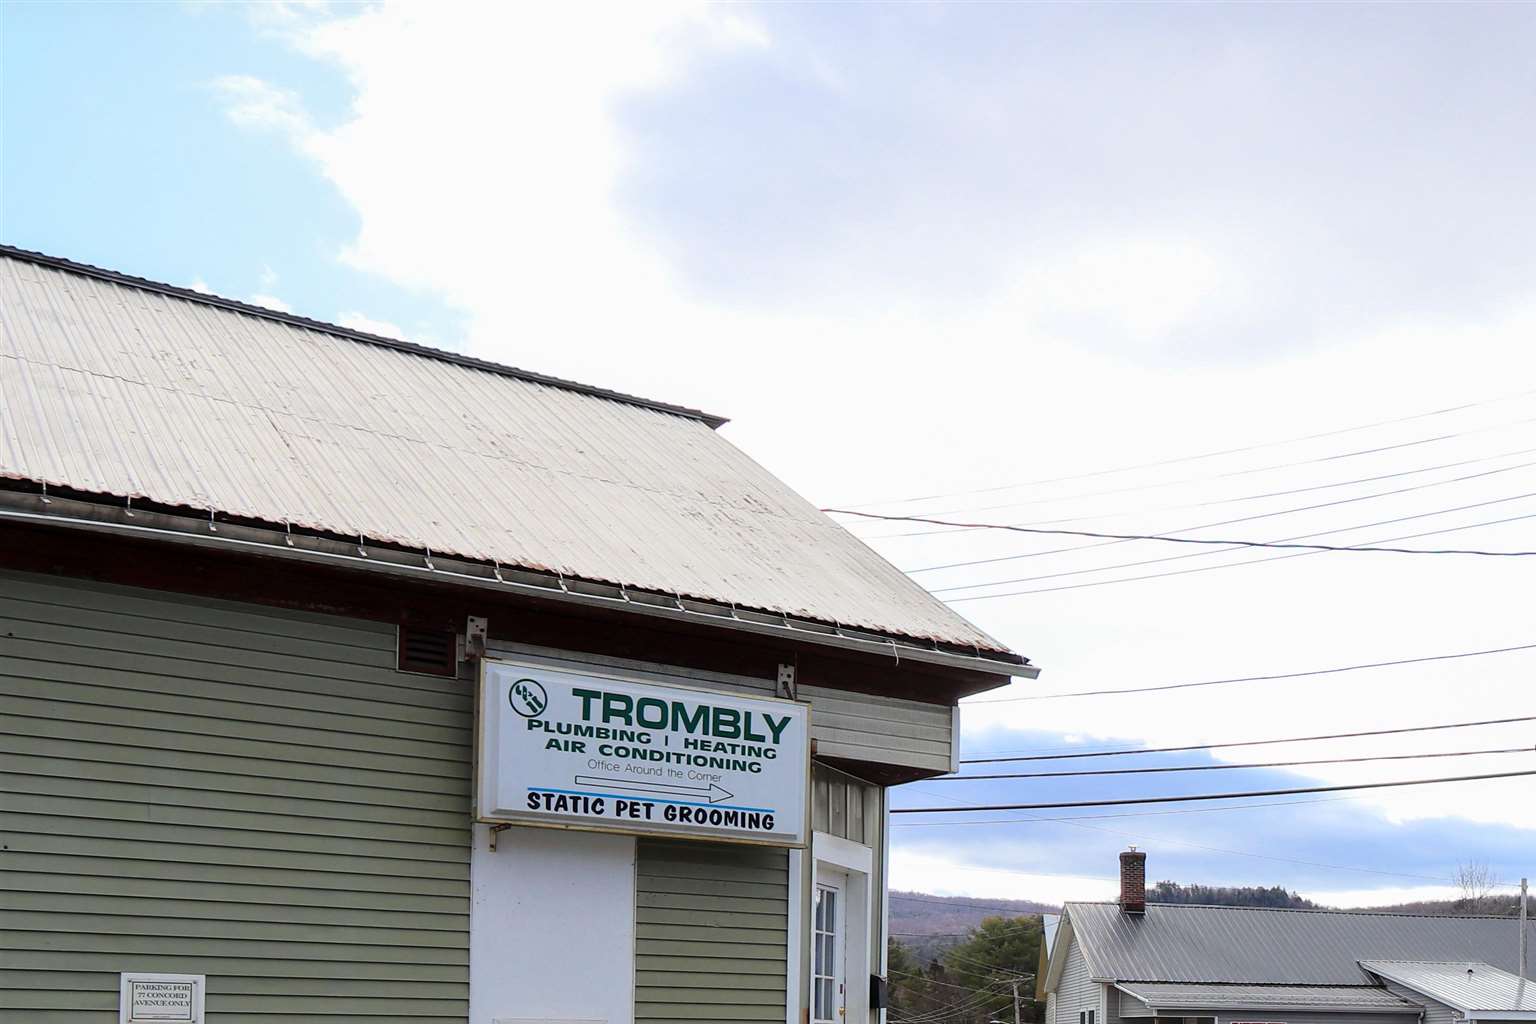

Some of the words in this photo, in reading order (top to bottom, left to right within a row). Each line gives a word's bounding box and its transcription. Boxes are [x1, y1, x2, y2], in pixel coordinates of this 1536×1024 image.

[572, 688, 792, 745] TROMBLY
[527, 719, 652, 745] PLUMBING
[684, 738, 777, 760] HEATING
[545, 738, 586, 754] AIR
[599, 744, 762, 773] CONDITIONING
[588, 758, 621, 773] Office
[624, 764, 663, 777] Around
[667, 768, 683, 780] the
[687, 770, 722, 783] Corner
[527, 792, 605, 815] STATIC
[616, 799, 655, 820] PET
[664, 805, 775, 830] GROOMING
